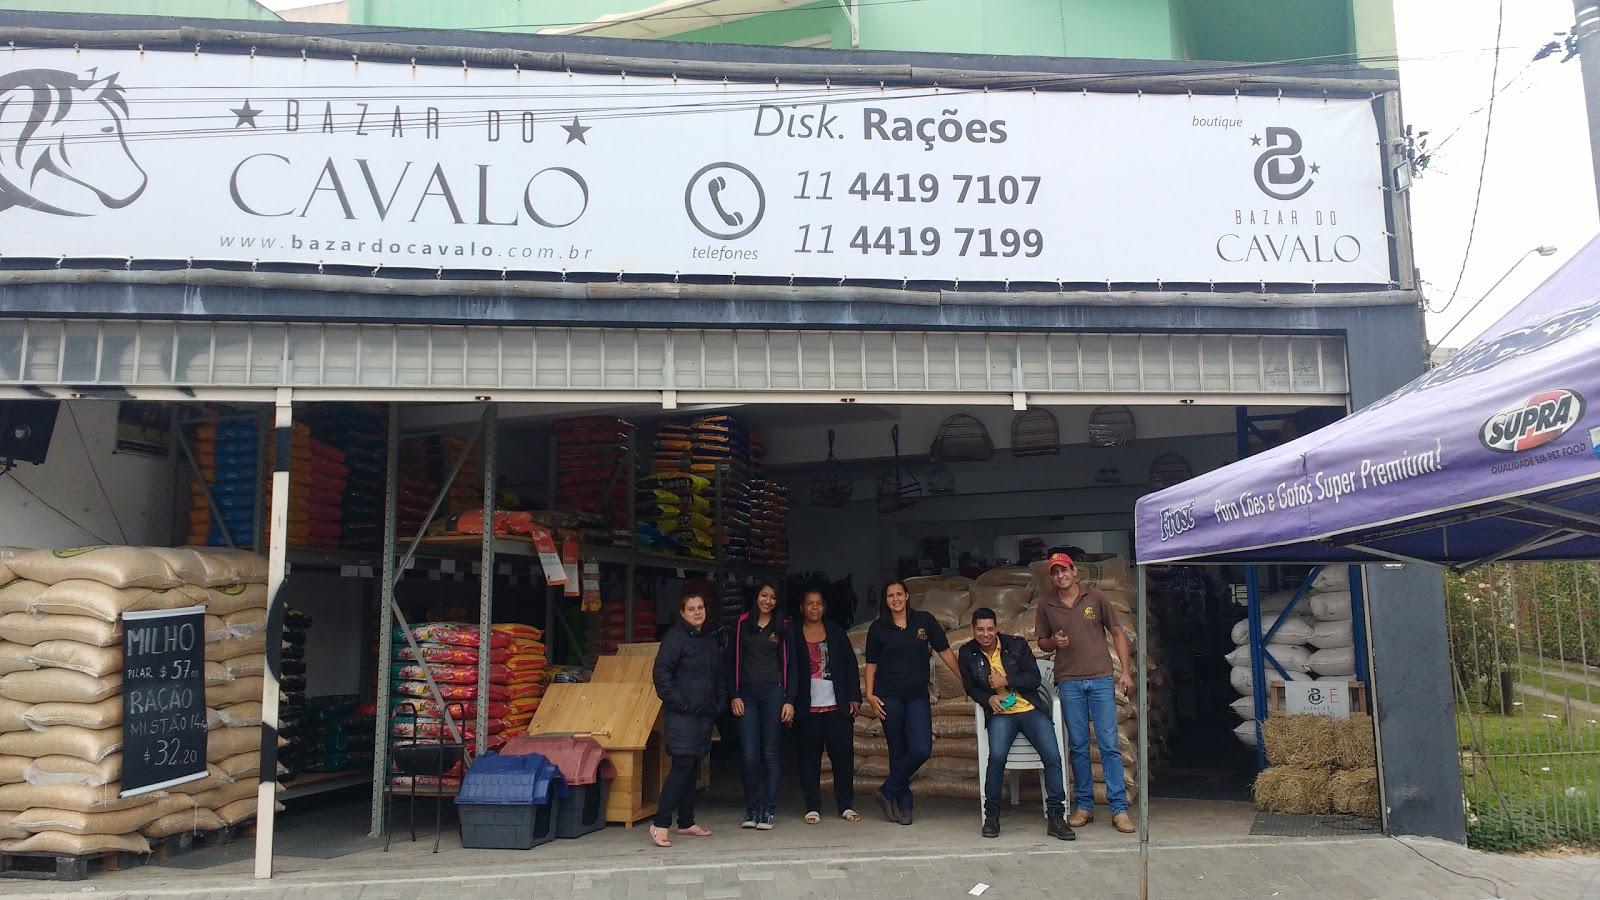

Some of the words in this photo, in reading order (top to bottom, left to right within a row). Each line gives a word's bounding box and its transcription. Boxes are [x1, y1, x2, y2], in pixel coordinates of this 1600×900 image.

[286, 99, 440, 140] BAZAR
[487, 110, 536, 144] DO
[753, 103, 846, 141] Disk.
[862, 107, 1009, 152] Rações
[1192, 114, 1244, 131] boutique
[228, 153, 591, 229] CAVALO
[793, 169, 834, 201] 11
[848, 170, 940, 203] 4419
[951, 174, 1042, 206] 7107
[1235, 209, 1299, 226] BAZAR
[1315, 210, 1338, 226] DO
[219, 233, 594, 261] www.bazardocavalo.com.br
[691, 244, 759, 262] telefones
[794, 223, 835, 255] 11
[849, 225, 942, 257] 4419
[953, 227, 1045, 259] 7199
[1215, 233, 1362, 264] CAVALO
[1487, 394, 1573, 445] SUPRA
[1491, 457, 1535, 475] QUALIDADE
[1562, 443, 1587, 457] FOOD
[1214, 499, 1240, 523] Para
[1239, 490, 1266, 518] Cães
[1268, 493, 1275, 511] e
[1276, 481, 1313, 510] Gatos
[1315, 471, 1356, 503] Super
[1360, 438, 1441, 489] Premium!
[126, 622, 196, 657] MILHO
[129, 685, 194, 715] RAÇÃO
[154, 737, 198, 767] 32.20
